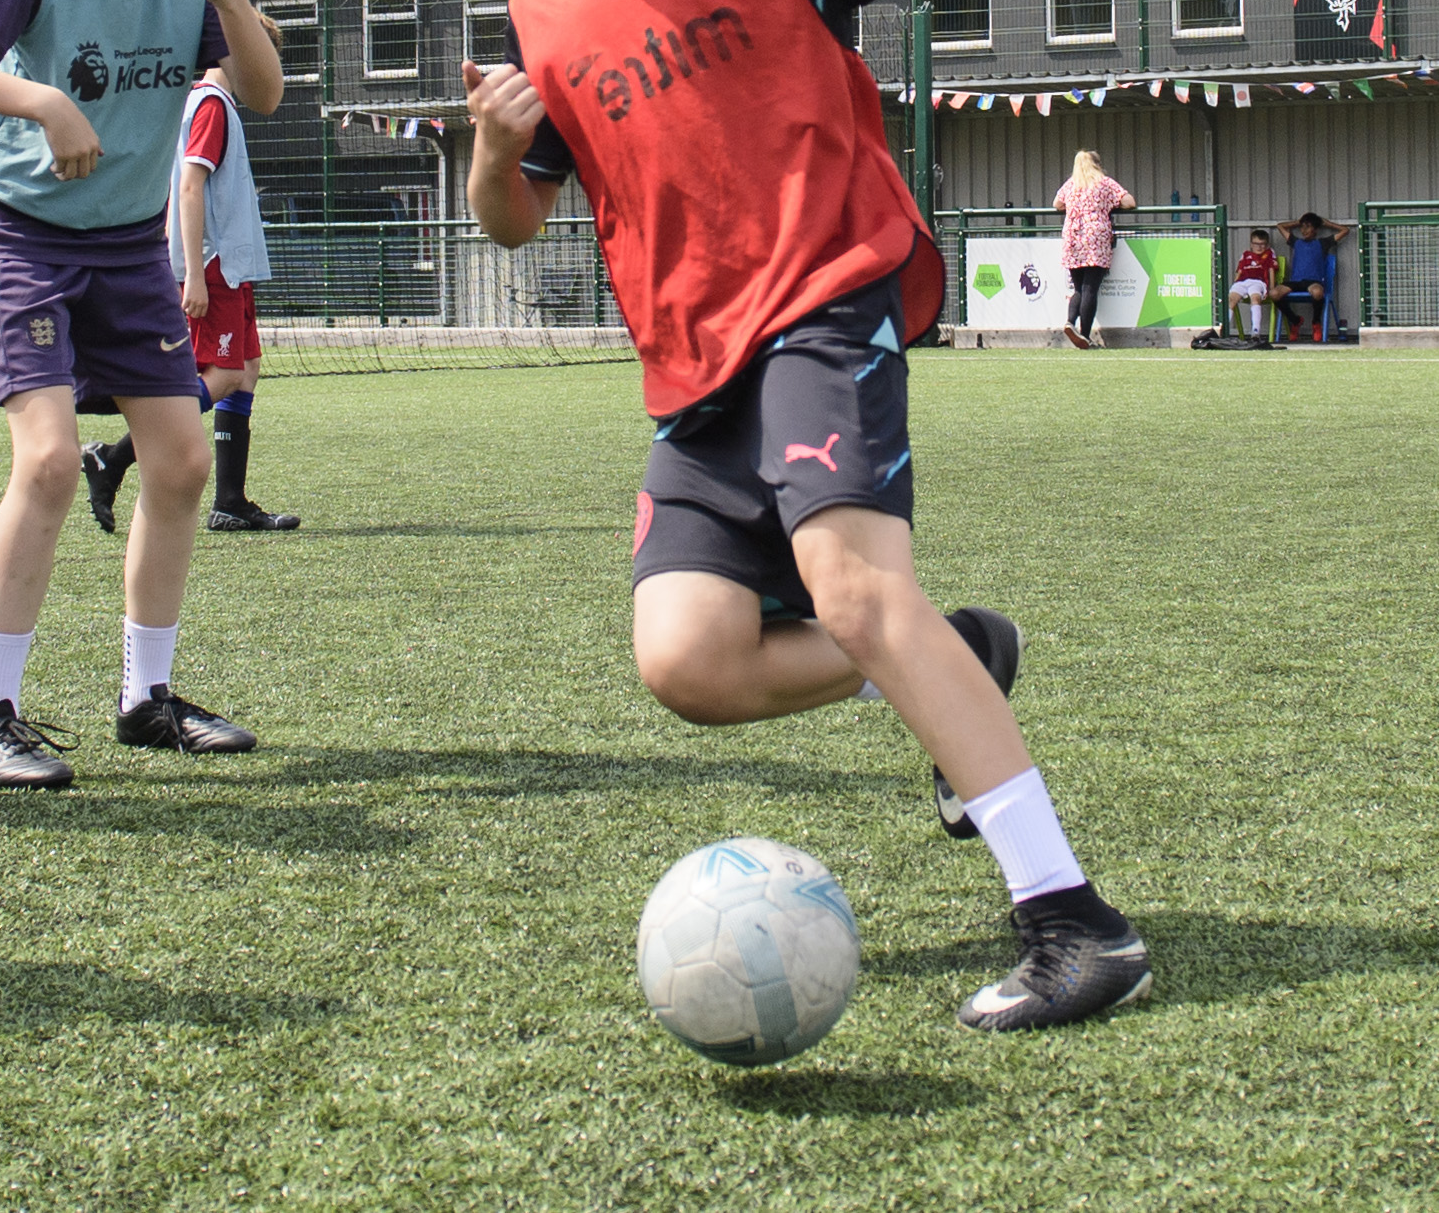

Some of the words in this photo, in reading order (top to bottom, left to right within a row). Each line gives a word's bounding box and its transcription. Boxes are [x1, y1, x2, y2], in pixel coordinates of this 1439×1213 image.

[137, 45, 174, 58] League
[114, 59, 187, 95] Kicks
[1163, 273, 1197, 286] TOGETHER
[1157, 285, 1171, 297] FOR
[1171, 285, 1203, 297] FOOTBALL
